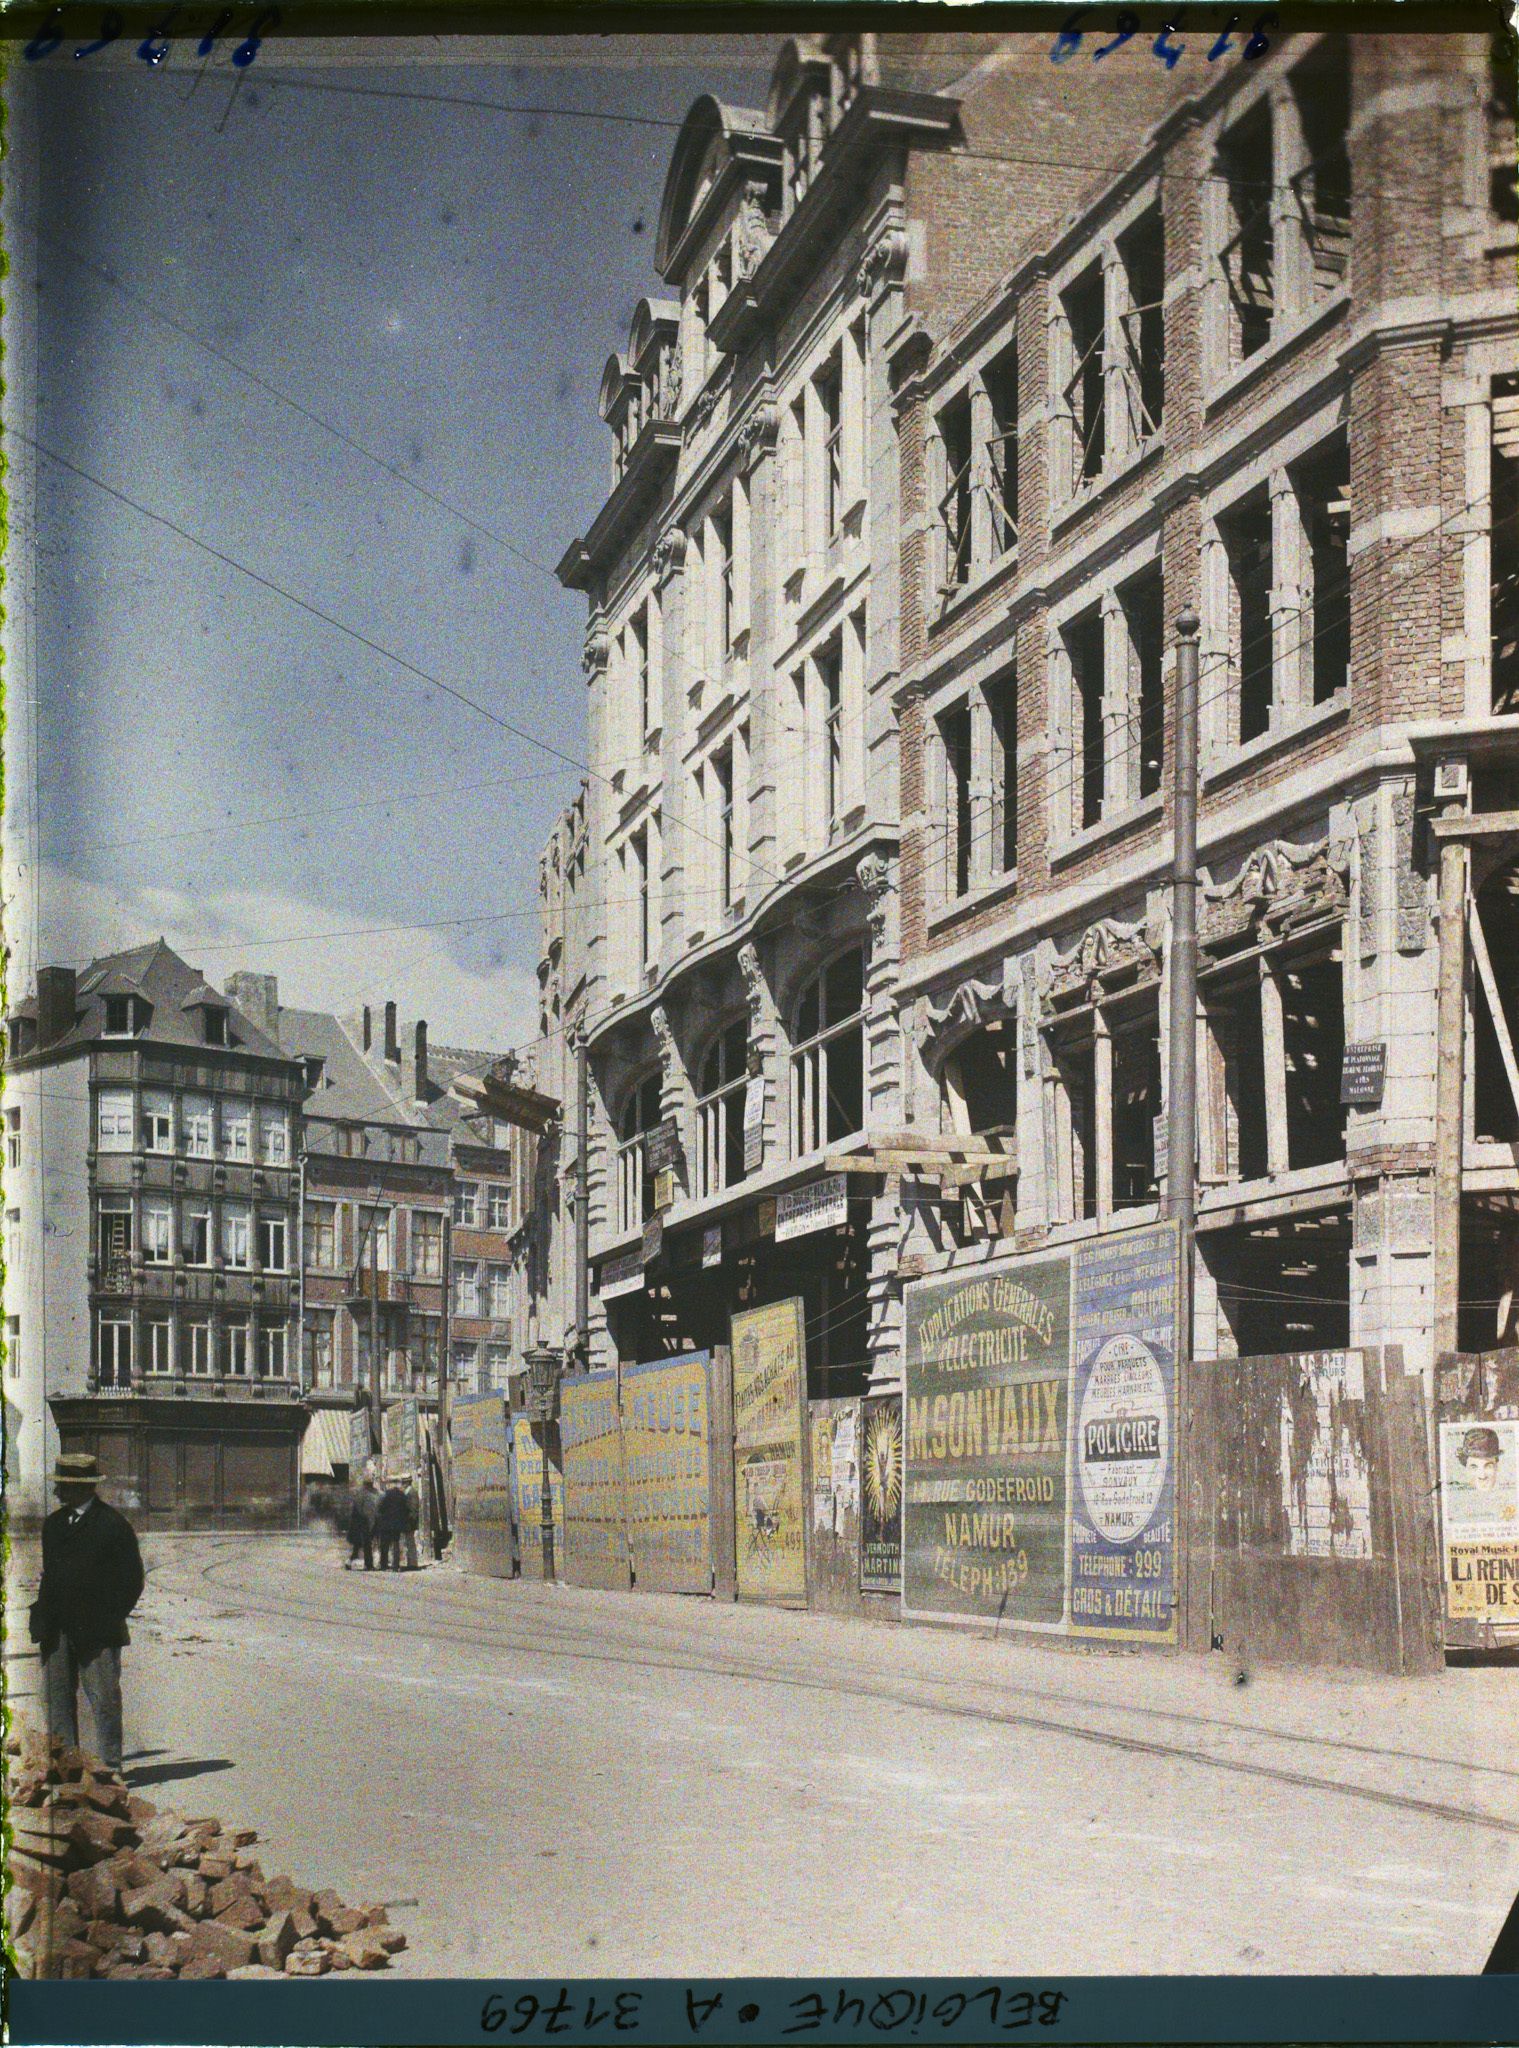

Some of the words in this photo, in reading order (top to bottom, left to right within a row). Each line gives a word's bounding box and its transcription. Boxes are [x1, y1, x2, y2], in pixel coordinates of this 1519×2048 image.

[1117, 1357, 1148, 1371] PARQUETS
[1087, 1419, 1159, 1457] POLICIRE
[965, 1476, 1054, 1503] GODEFROID
[945, 1512, 1015, 1548] NAMUR
[1104, 1511, 1135, 1527] NAMUR
[866, 1542, 900, 1555] VERMOUTH
[1450, 1546, 1478, 1555] Royal
[1134, 1550, 1162, 1579] 299
[1073, 1587, 1102, 1614] GROS
[1115, 1585, 1167, 1620] DÉTAIL
[1486, 1583, 1507, 1605] DE
